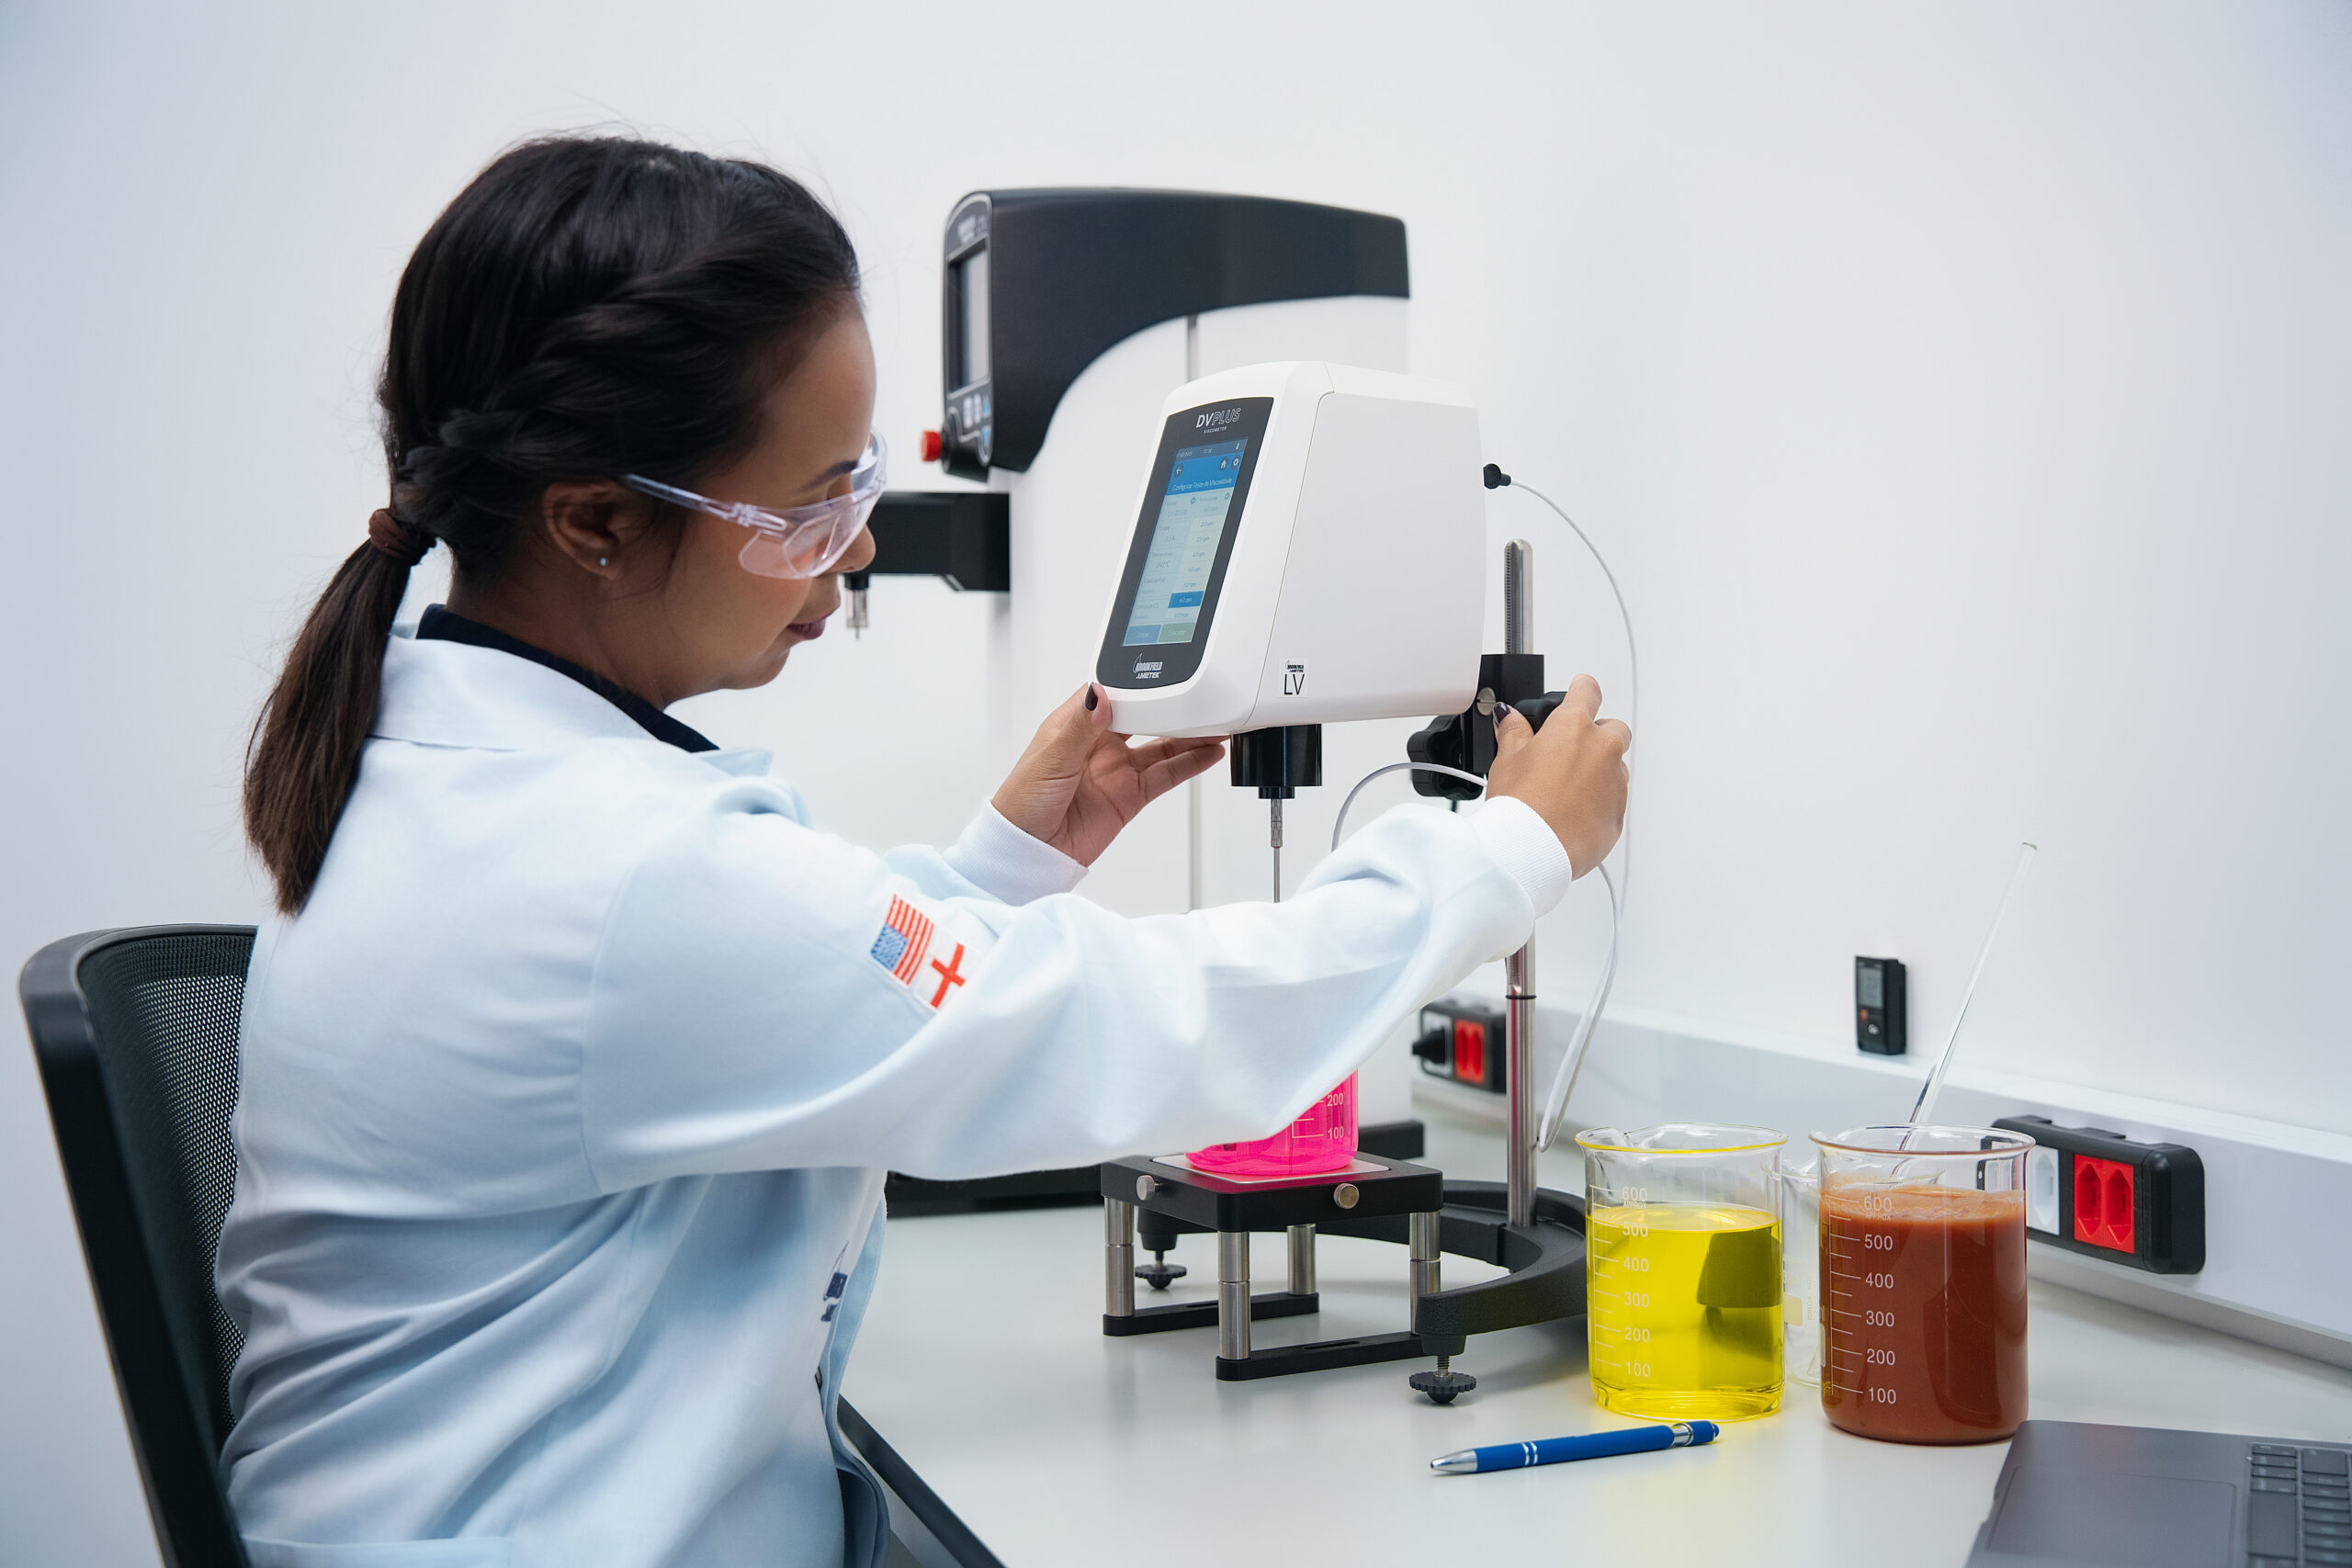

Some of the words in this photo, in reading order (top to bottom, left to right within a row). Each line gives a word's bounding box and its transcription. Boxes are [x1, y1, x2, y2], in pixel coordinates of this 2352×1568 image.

[1284, 673, 1306, 695] LV
[1327, 1093, 1344, 1107] 200
[1327, 1126, 1344, 1139] 100
[1622, 1186, 1647, 1202] 600
[1863, 1196, 1892, 1213] 600
[1623, 1222, 1648, 1237] 500
[1864, 1235, 1894, 1250] 500
[1623, 1257, 1649, 1272] 400
[1865, 1272, 1894, 1289] 400
[1623, 1292, 1649, 1308] 300
[1866, 1310, 1895, 1327] 300
[1624, 1326, 1650, 1342] 200
[1866, 1348, 1896, 1366] 200
[1625, 1360, 1651, 1378] 100
[1868, 1387, 1897, 1404] 100
